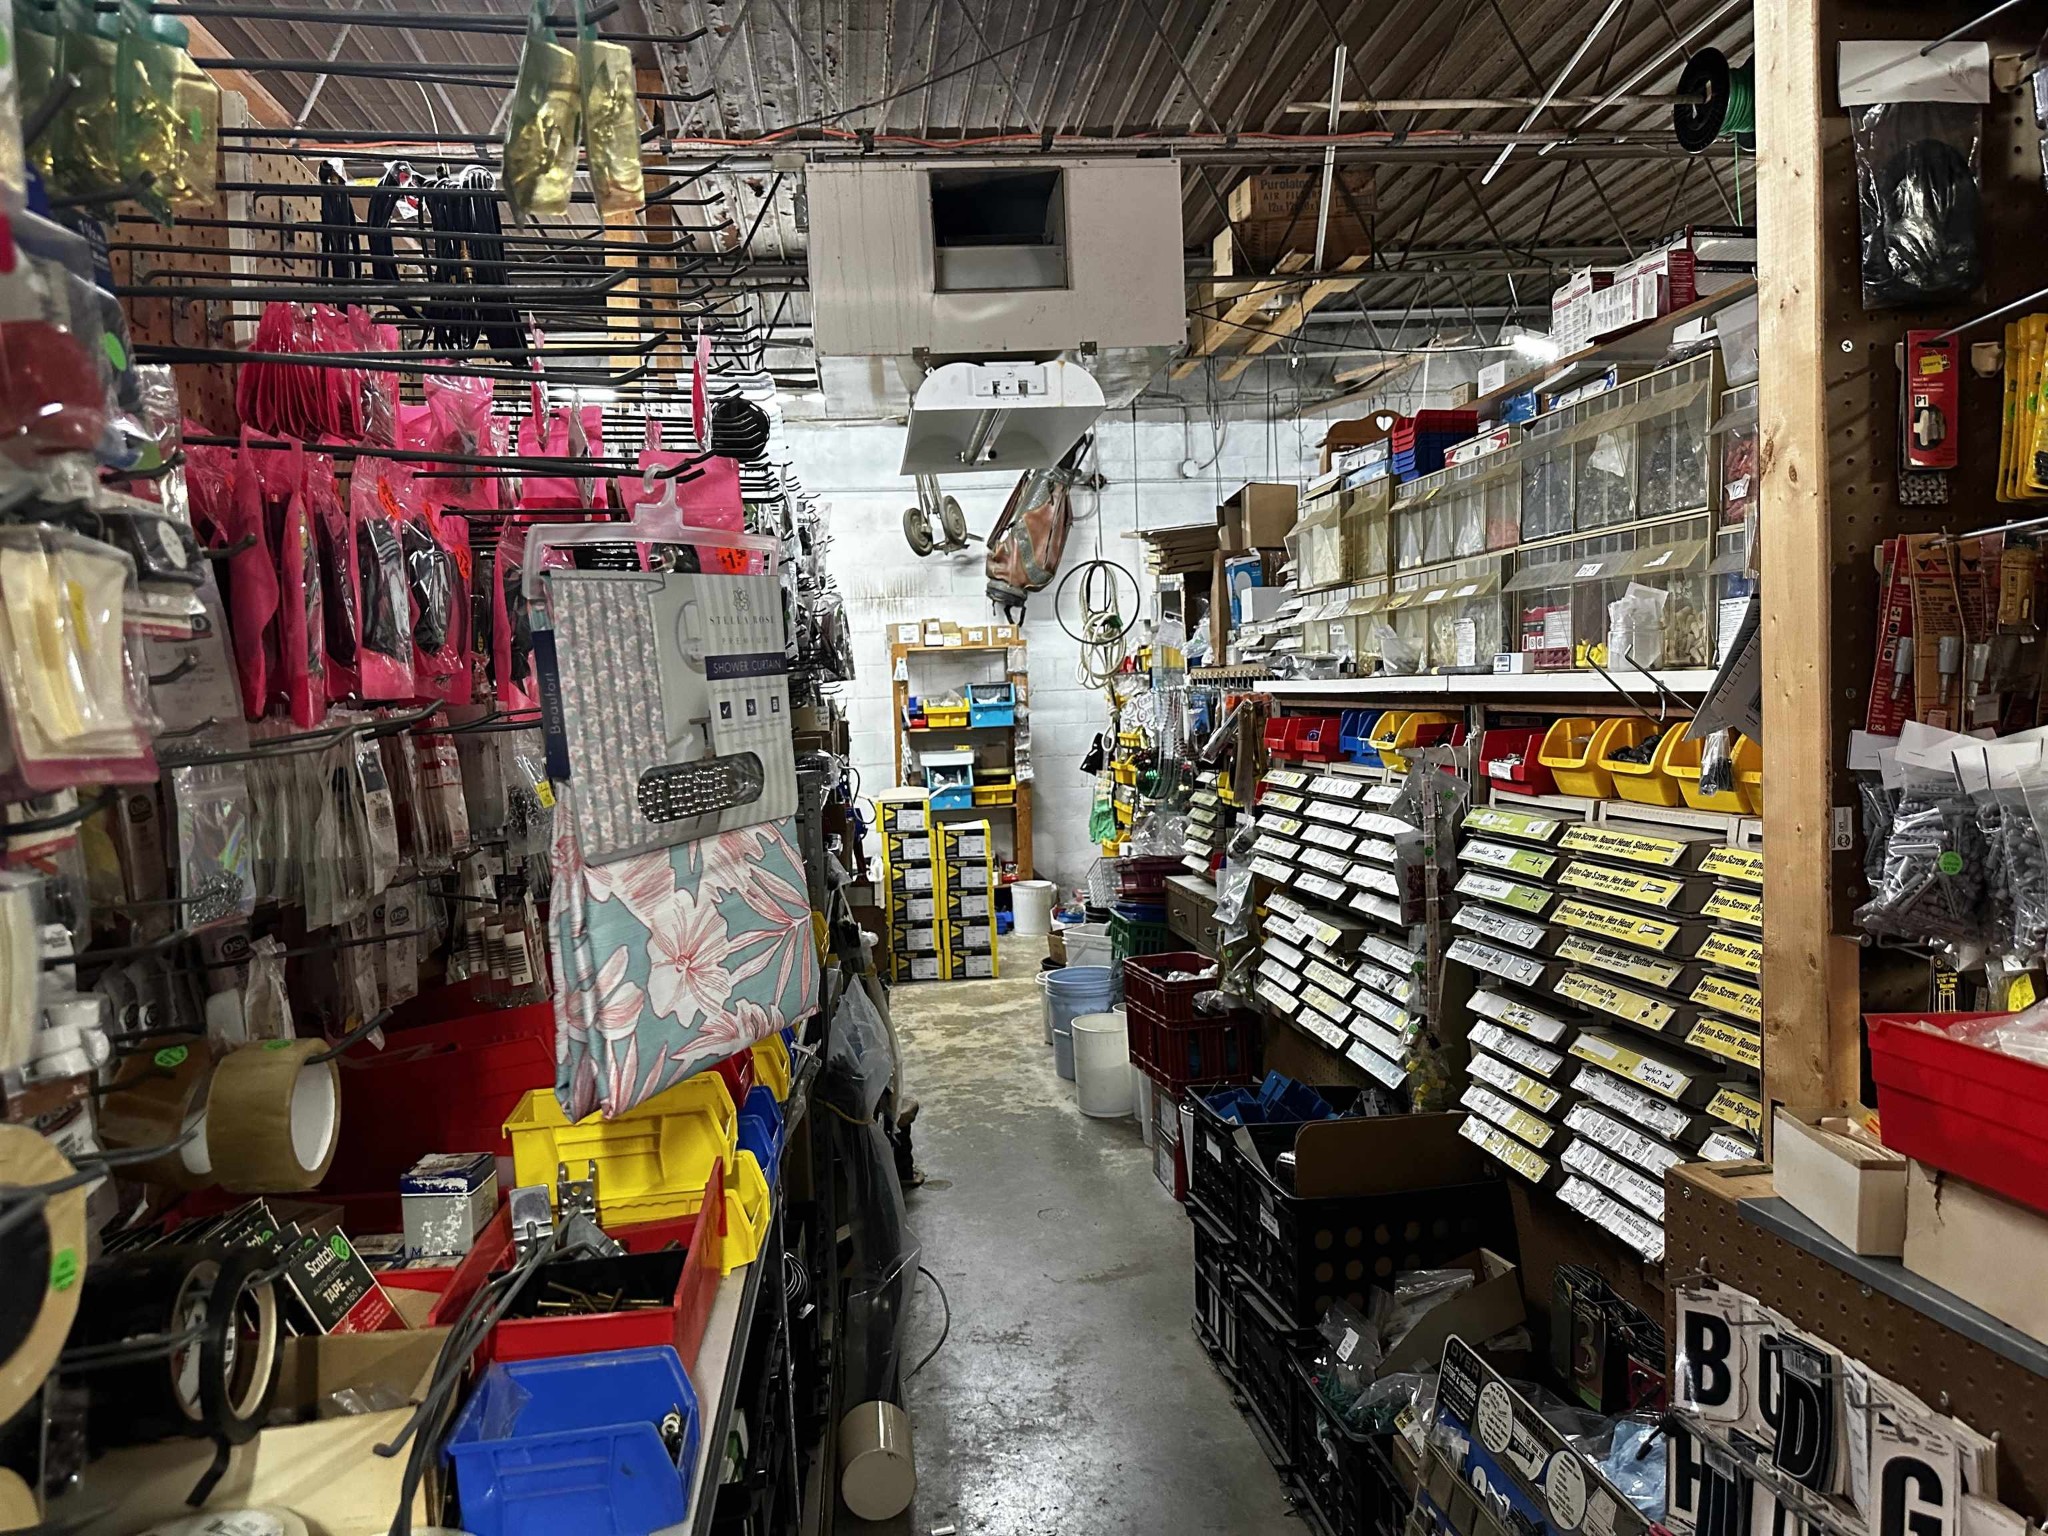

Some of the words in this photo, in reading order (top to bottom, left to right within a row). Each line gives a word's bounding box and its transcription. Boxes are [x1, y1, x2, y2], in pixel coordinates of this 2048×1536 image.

[1916, 396, 1927, 406] P1
[710, 616, 748, 625] STELLA
[753, 615, 774, 625] ROSE
[722, 637, 768, 646] PREMIUM
[713, 661, 749, 674] SHOWER
[752, 659, 781, 671] CURTAIN
[544, 673, 561, 734] Beaufort
[1871, 723, 1886, 732] USA
[1567, 830, 1582, 840] Nylon
[1581, 832, 1599, 843] Screw,
[1600, 835, 1618, 845] Round
[1616, 837, 1633, 848] Head,
[1633, 840, 1655, 851] Slotted
[1707, 851, 1726, 862] Nylon
[1725, 854, 1747, 868] Screw,
[1566, 866, 1581, 876] Nylon
[1581, 869, 1593, 879] Cap
[1591, 871, 1609, 883] Screw,
[1610, 875, 1621, 884] Hex
[1620, 877, 1638, 888] Head
[1710, 894, 1729, 906] Nylon
[1728, 898, 1752, 912] Screw,
[1560, 904, 1576, 915] Nylon
[1575, 907, 1587, 919] Cap
[1586, 910, 1606, 923] Screw,
[1605, 915, 1618, 925] Hex
[1617, 917, 1636, 929] Head
[1565, 937, 1581, 948] Nylon
[1581, 941, 1597, 954] Screw,
[1596, 944, 1616, 958] Binder
[1631, 954, 1654, 968] Slotted
[1706, 938, 1725, 950] Nylon
[1724, 943, 1747, 957] Screw,
[1562, 974, 1578, 986] Screw
[1699, 981, 1718, 994] Nylon
[1717, 986, 1738, 1002] Screw,
[1740, 993, 1756, 1005] Flat
[1696, 1022, 1715, 1036] Nylon
[1714, 1029, 1736, 1046] Screw,
[1716, 1094, 1735, 1109] Nylon
[1734, 1102, 1760, 1120] Spacer
[305, 1246, 336, 1278] Scotch
[323, 1278, 346, 1304] TAPE
[1574, 1315, 1598, 1378] 3
[1684, 1310, 1731, 1406] B
[1777, 1370, 1820, 1479] D
[1880, 1456, 1943, 1536] G
